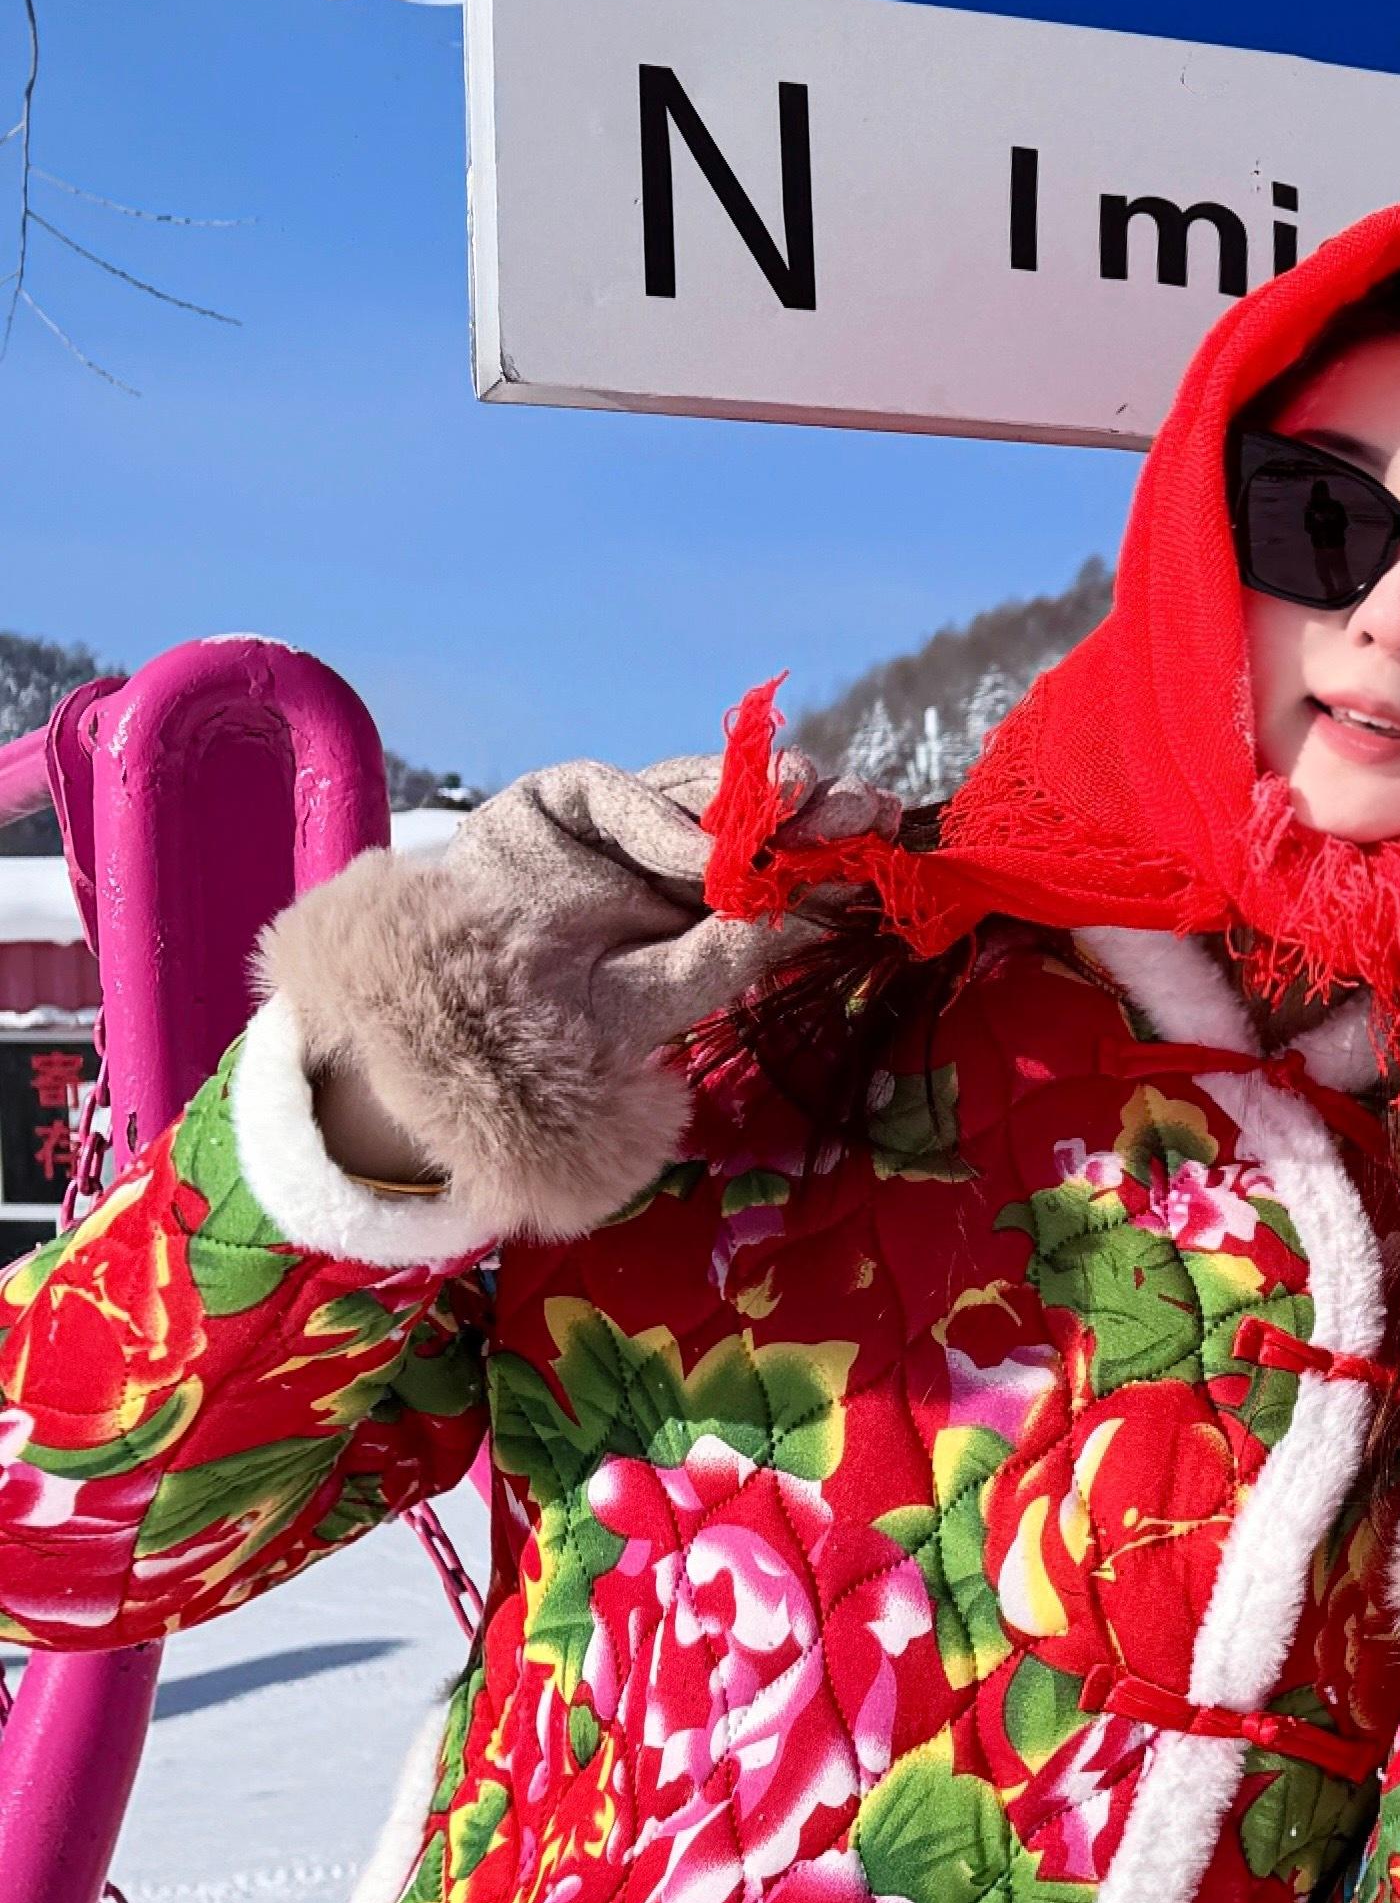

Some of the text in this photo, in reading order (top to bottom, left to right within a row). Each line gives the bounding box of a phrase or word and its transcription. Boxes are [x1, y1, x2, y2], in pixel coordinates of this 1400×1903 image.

[637, 62, 816, 310] N
[1008, 146, 1040, 271] I
[1098, 181, 1310, 296] mi
